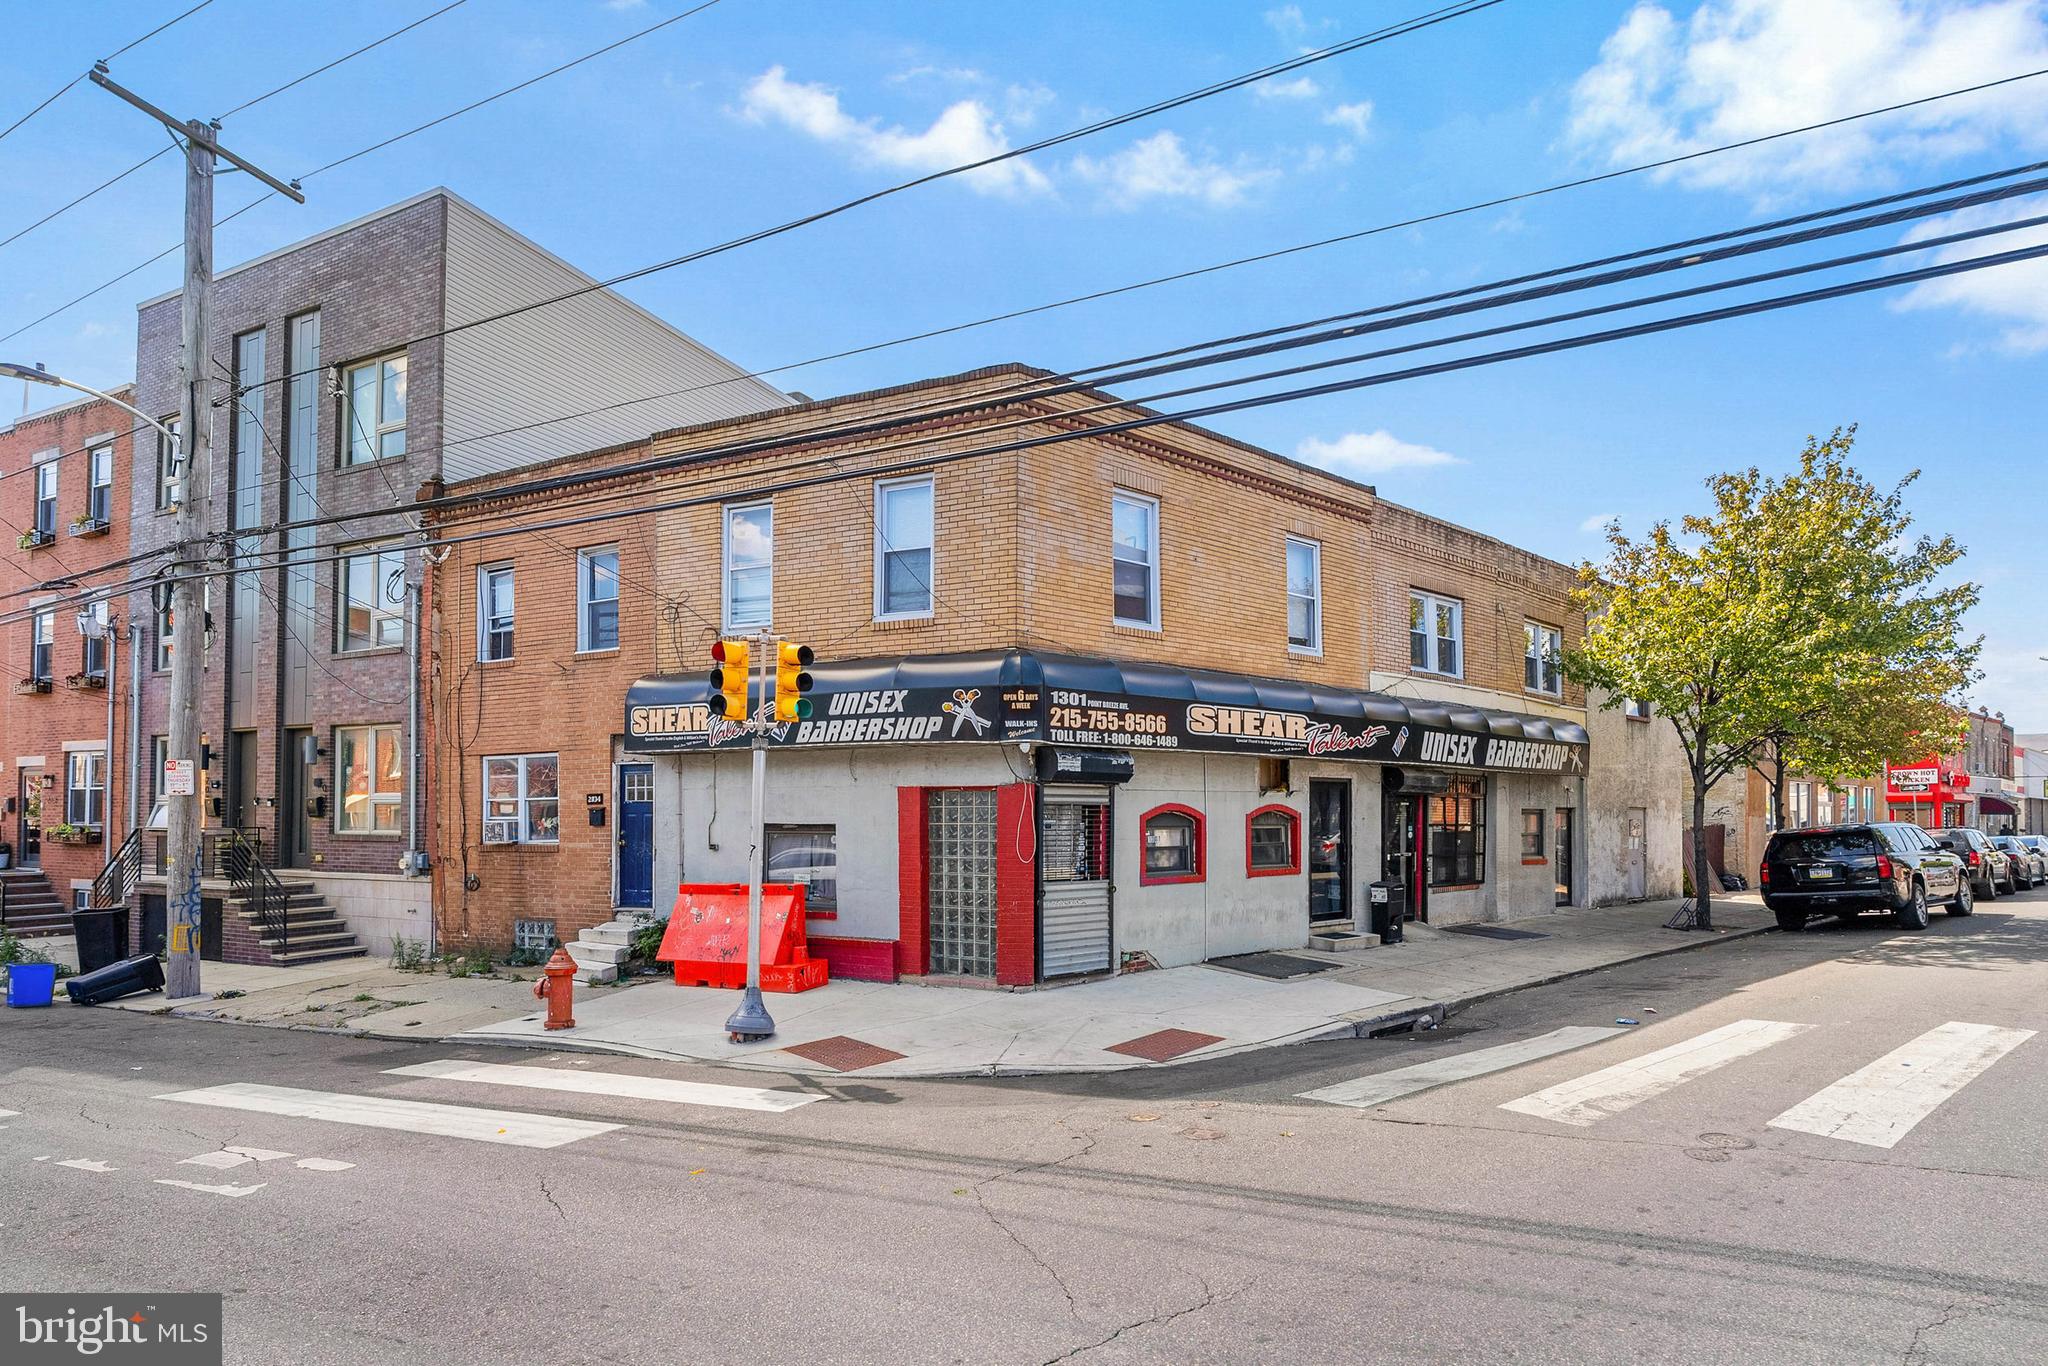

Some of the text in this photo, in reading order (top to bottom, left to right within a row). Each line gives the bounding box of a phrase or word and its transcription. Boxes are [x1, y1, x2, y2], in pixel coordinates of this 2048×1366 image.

[828, 689, 909, 716] UNISEX
[1003, 690, 1039, 701] OPEN 6 DAYS
[1050, 690, 1087, 707] 1301
[1088, 700, 1102, 708] POINT
[632, 706, 709, 735] SHEAR
[795, 716, 944, 744] BARBERSHOP
[1004, 720, 1038, 728] WALK-INS
[1008, 728, 1036, 738] Welcome
[1050, 706, 1167, 734] 215-755-8566
[1189, 705, 1307, 740] SHEAR
[1050, 729, 1178, 748] TOLL FREE: 1-800-646-1489
[1305, 723, 1390, 755] Talent
[1421, 730, 1570, 771] UNISEX BARBERSHOP
